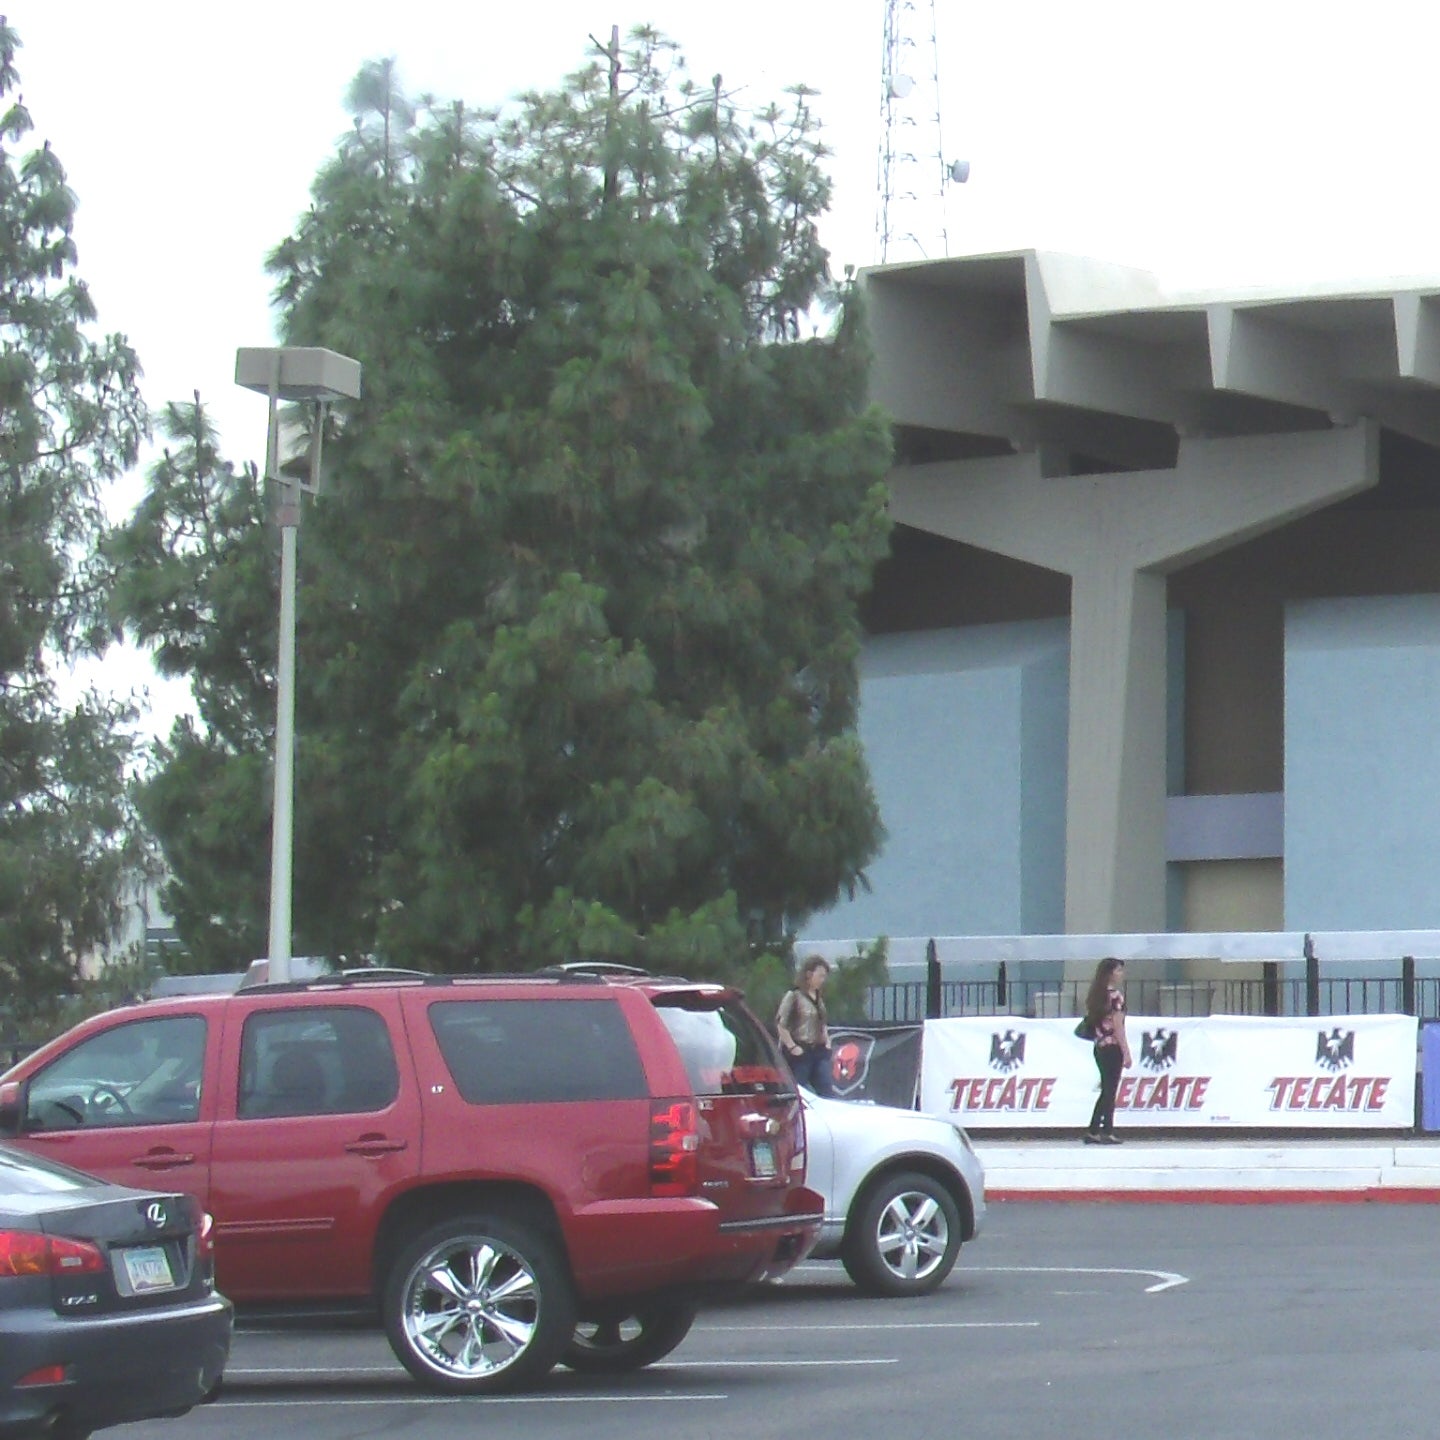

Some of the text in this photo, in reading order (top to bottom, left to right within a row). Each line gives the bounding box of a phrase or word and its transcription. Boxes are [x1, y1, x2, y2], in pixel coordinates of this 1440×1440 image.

[946, 1075, 1058, 1113] TECATE
[1114, 1074, 1213, 1112] ECATE
[1265, 1074, 1393, 1113] TECATE
